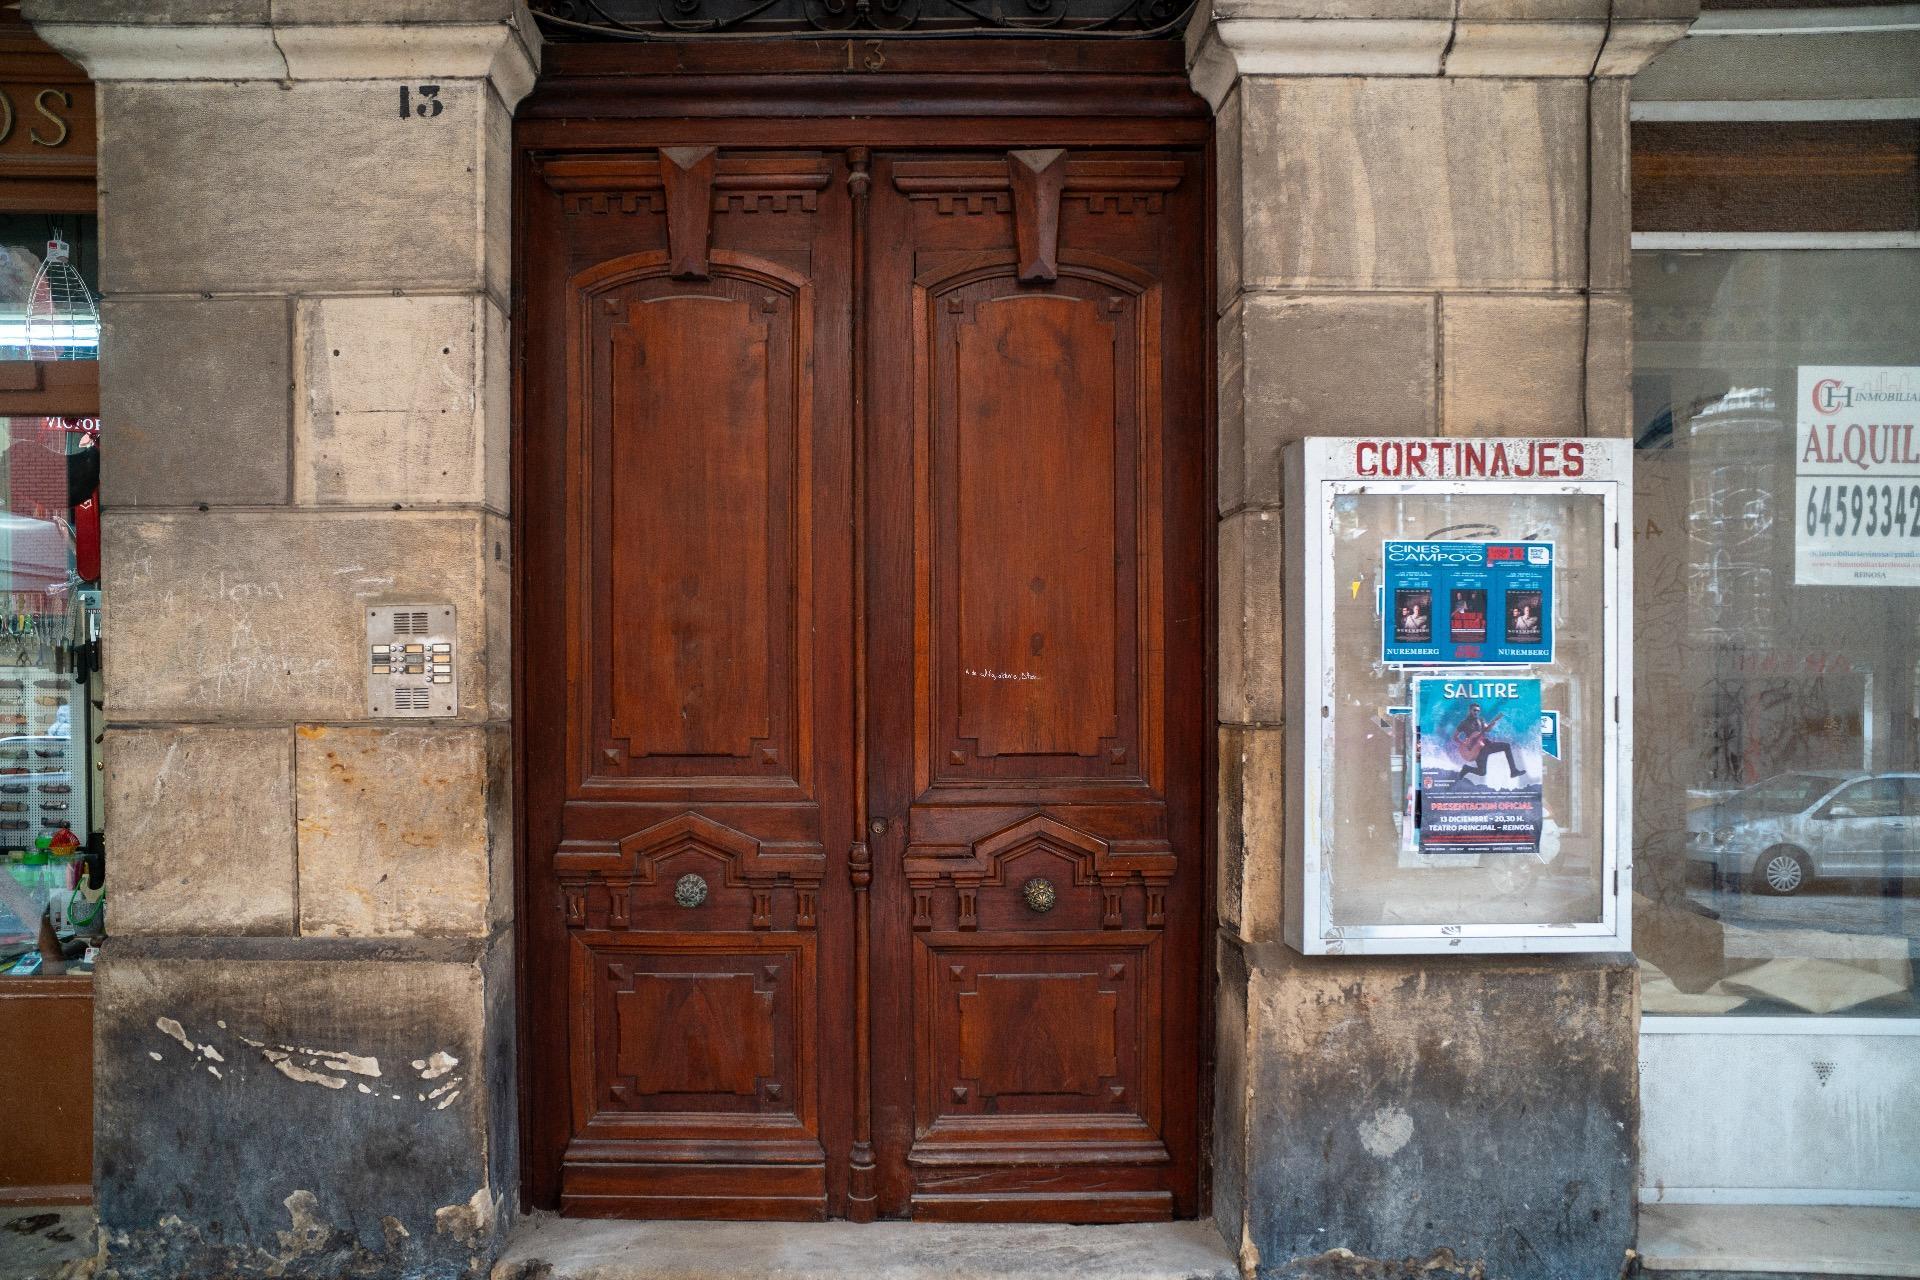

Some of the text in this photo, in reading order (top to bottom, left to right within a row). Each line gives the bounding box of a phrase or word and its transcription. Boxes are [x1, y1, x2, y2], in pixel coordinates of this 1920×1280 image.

[841, 39, 887, 73] 13
[399, 85, 444, 119] 13
[1356, 441, 1585, 477] CORTINAJES
[1806, 484, 1920, 538] 64593342
[1388, 544, 1441, 554] CINES
[1388, 553, 1483, 562] CAMPOO
[1854, 571, 1887, 579] REINOSA
[1386, 648, 1440, 656] NUREMBERG
[1498, 648, 1550, 656] NUREMBERG
[1443, 683, 1519, 699] SALITRE
[1448, 815, 1488, 823] DICIEMBRE
[1429, 824, 1457, 832] TEATRO
[1502, 823, 1535, 831] REINOSA
